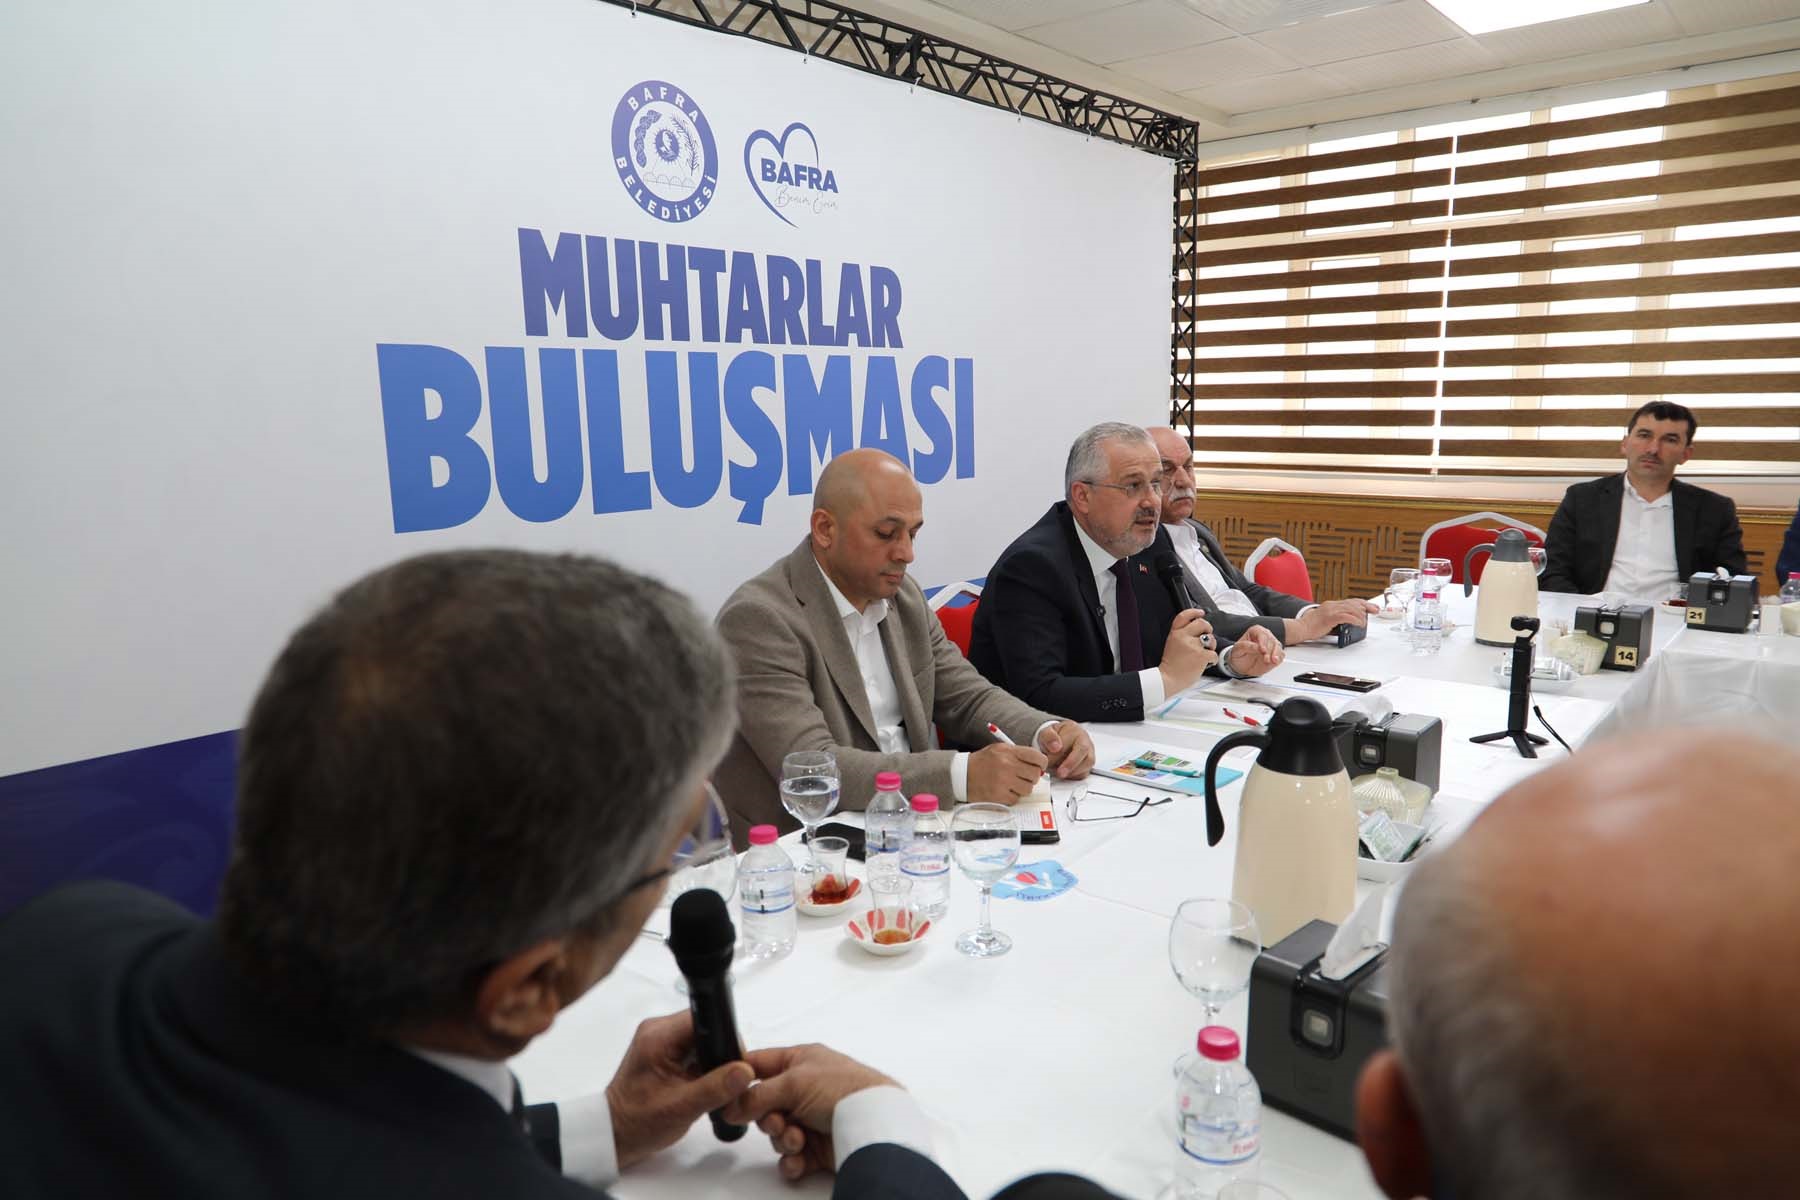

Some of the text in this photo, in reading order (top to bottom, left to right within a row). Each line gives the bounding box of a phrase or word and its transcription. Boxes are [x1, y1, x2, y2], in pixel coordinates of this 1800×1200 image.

[627, 86, 699, 123] BAFRA
[615, 156, 716, 221] BELEDİYESİ
[760, 157, 839, 194] BAFRA
[517, 227, 904, 349] MUHTARLAR
[376, 343, 976, 534] BULUŞMASI
[1689, 611, 1703, 620] 21
[1618, 651, 1634, 661] 14
